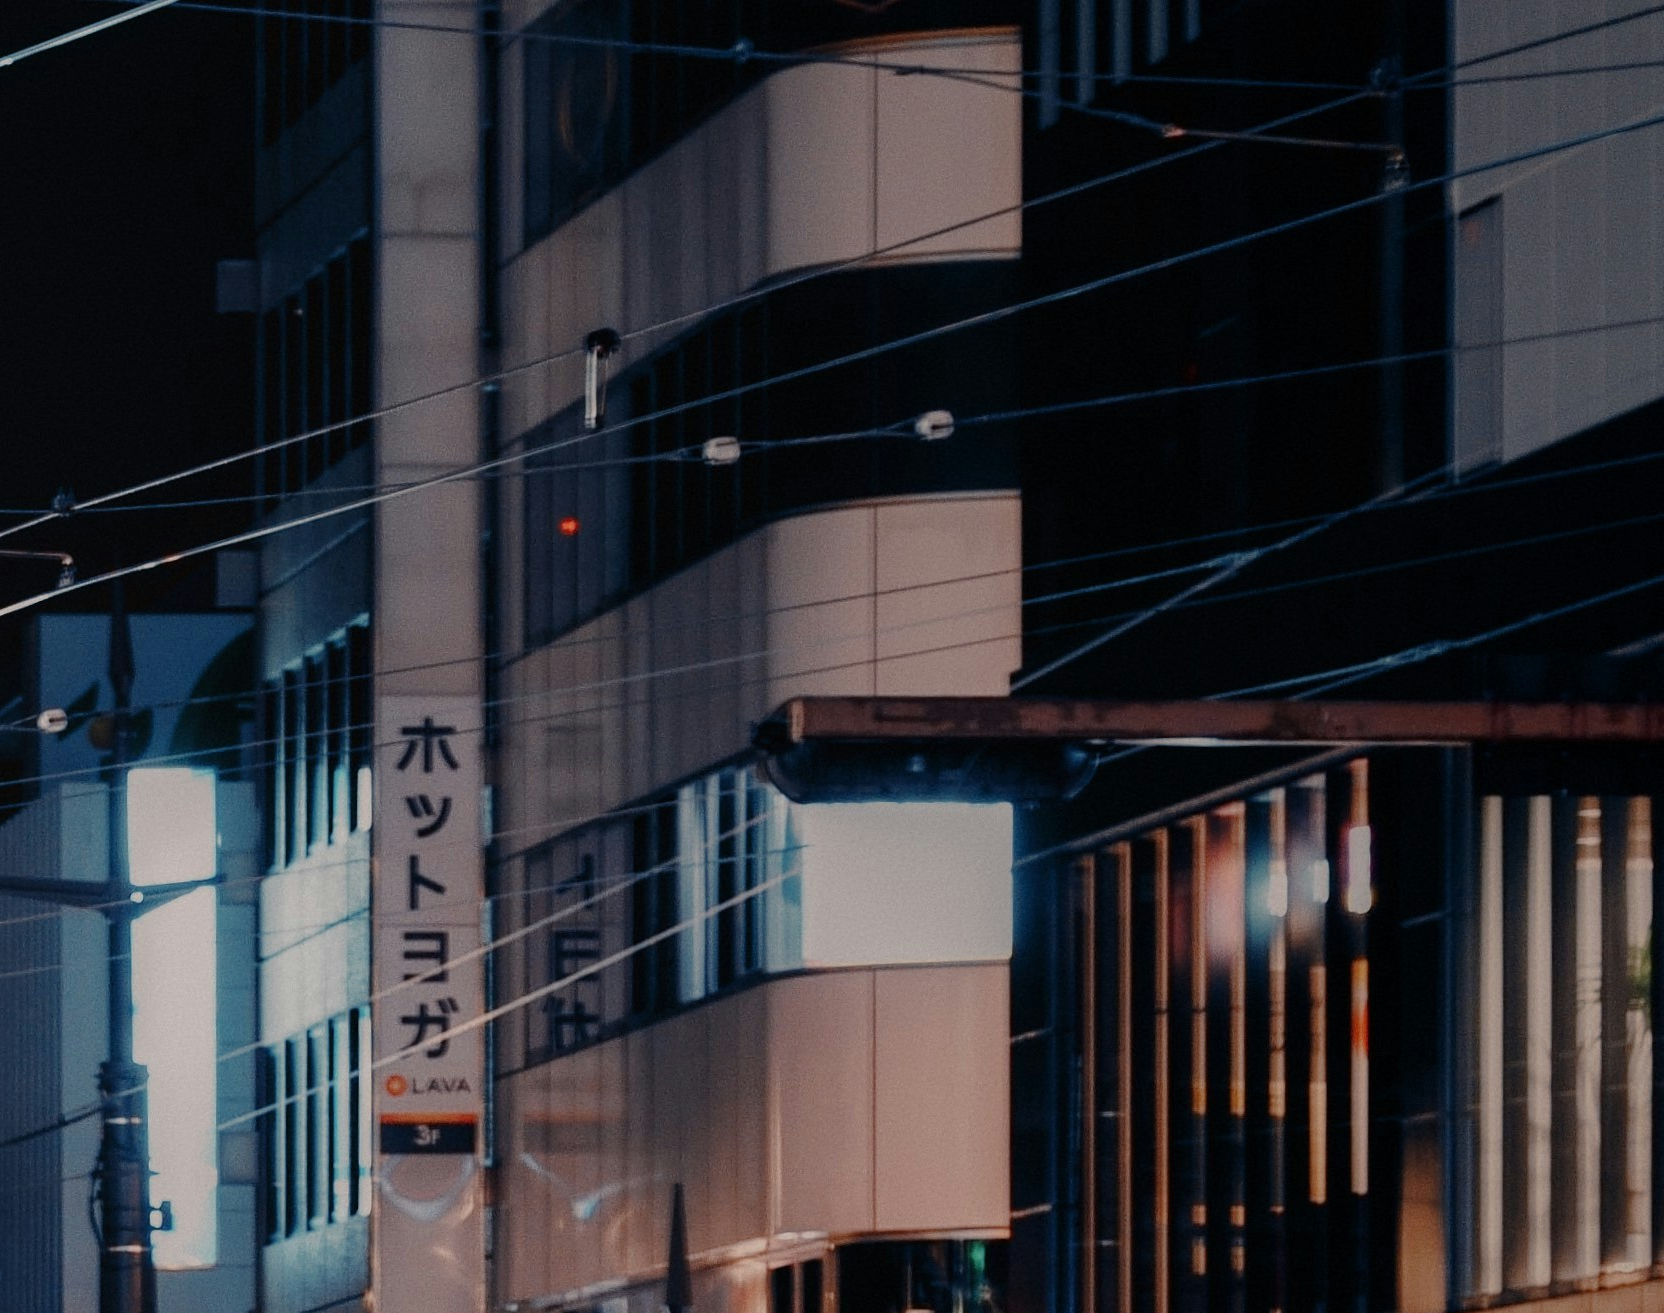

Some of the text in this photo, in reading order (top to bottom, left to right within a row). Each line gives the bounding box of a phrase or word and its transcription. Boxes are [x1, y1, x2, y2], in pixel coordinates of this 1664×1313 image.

[397, 717, 459, 1059] ホットヨガ
[412, 1078, 471, 1094] LAVA
[414, 1125, 442, 1146] 3F
